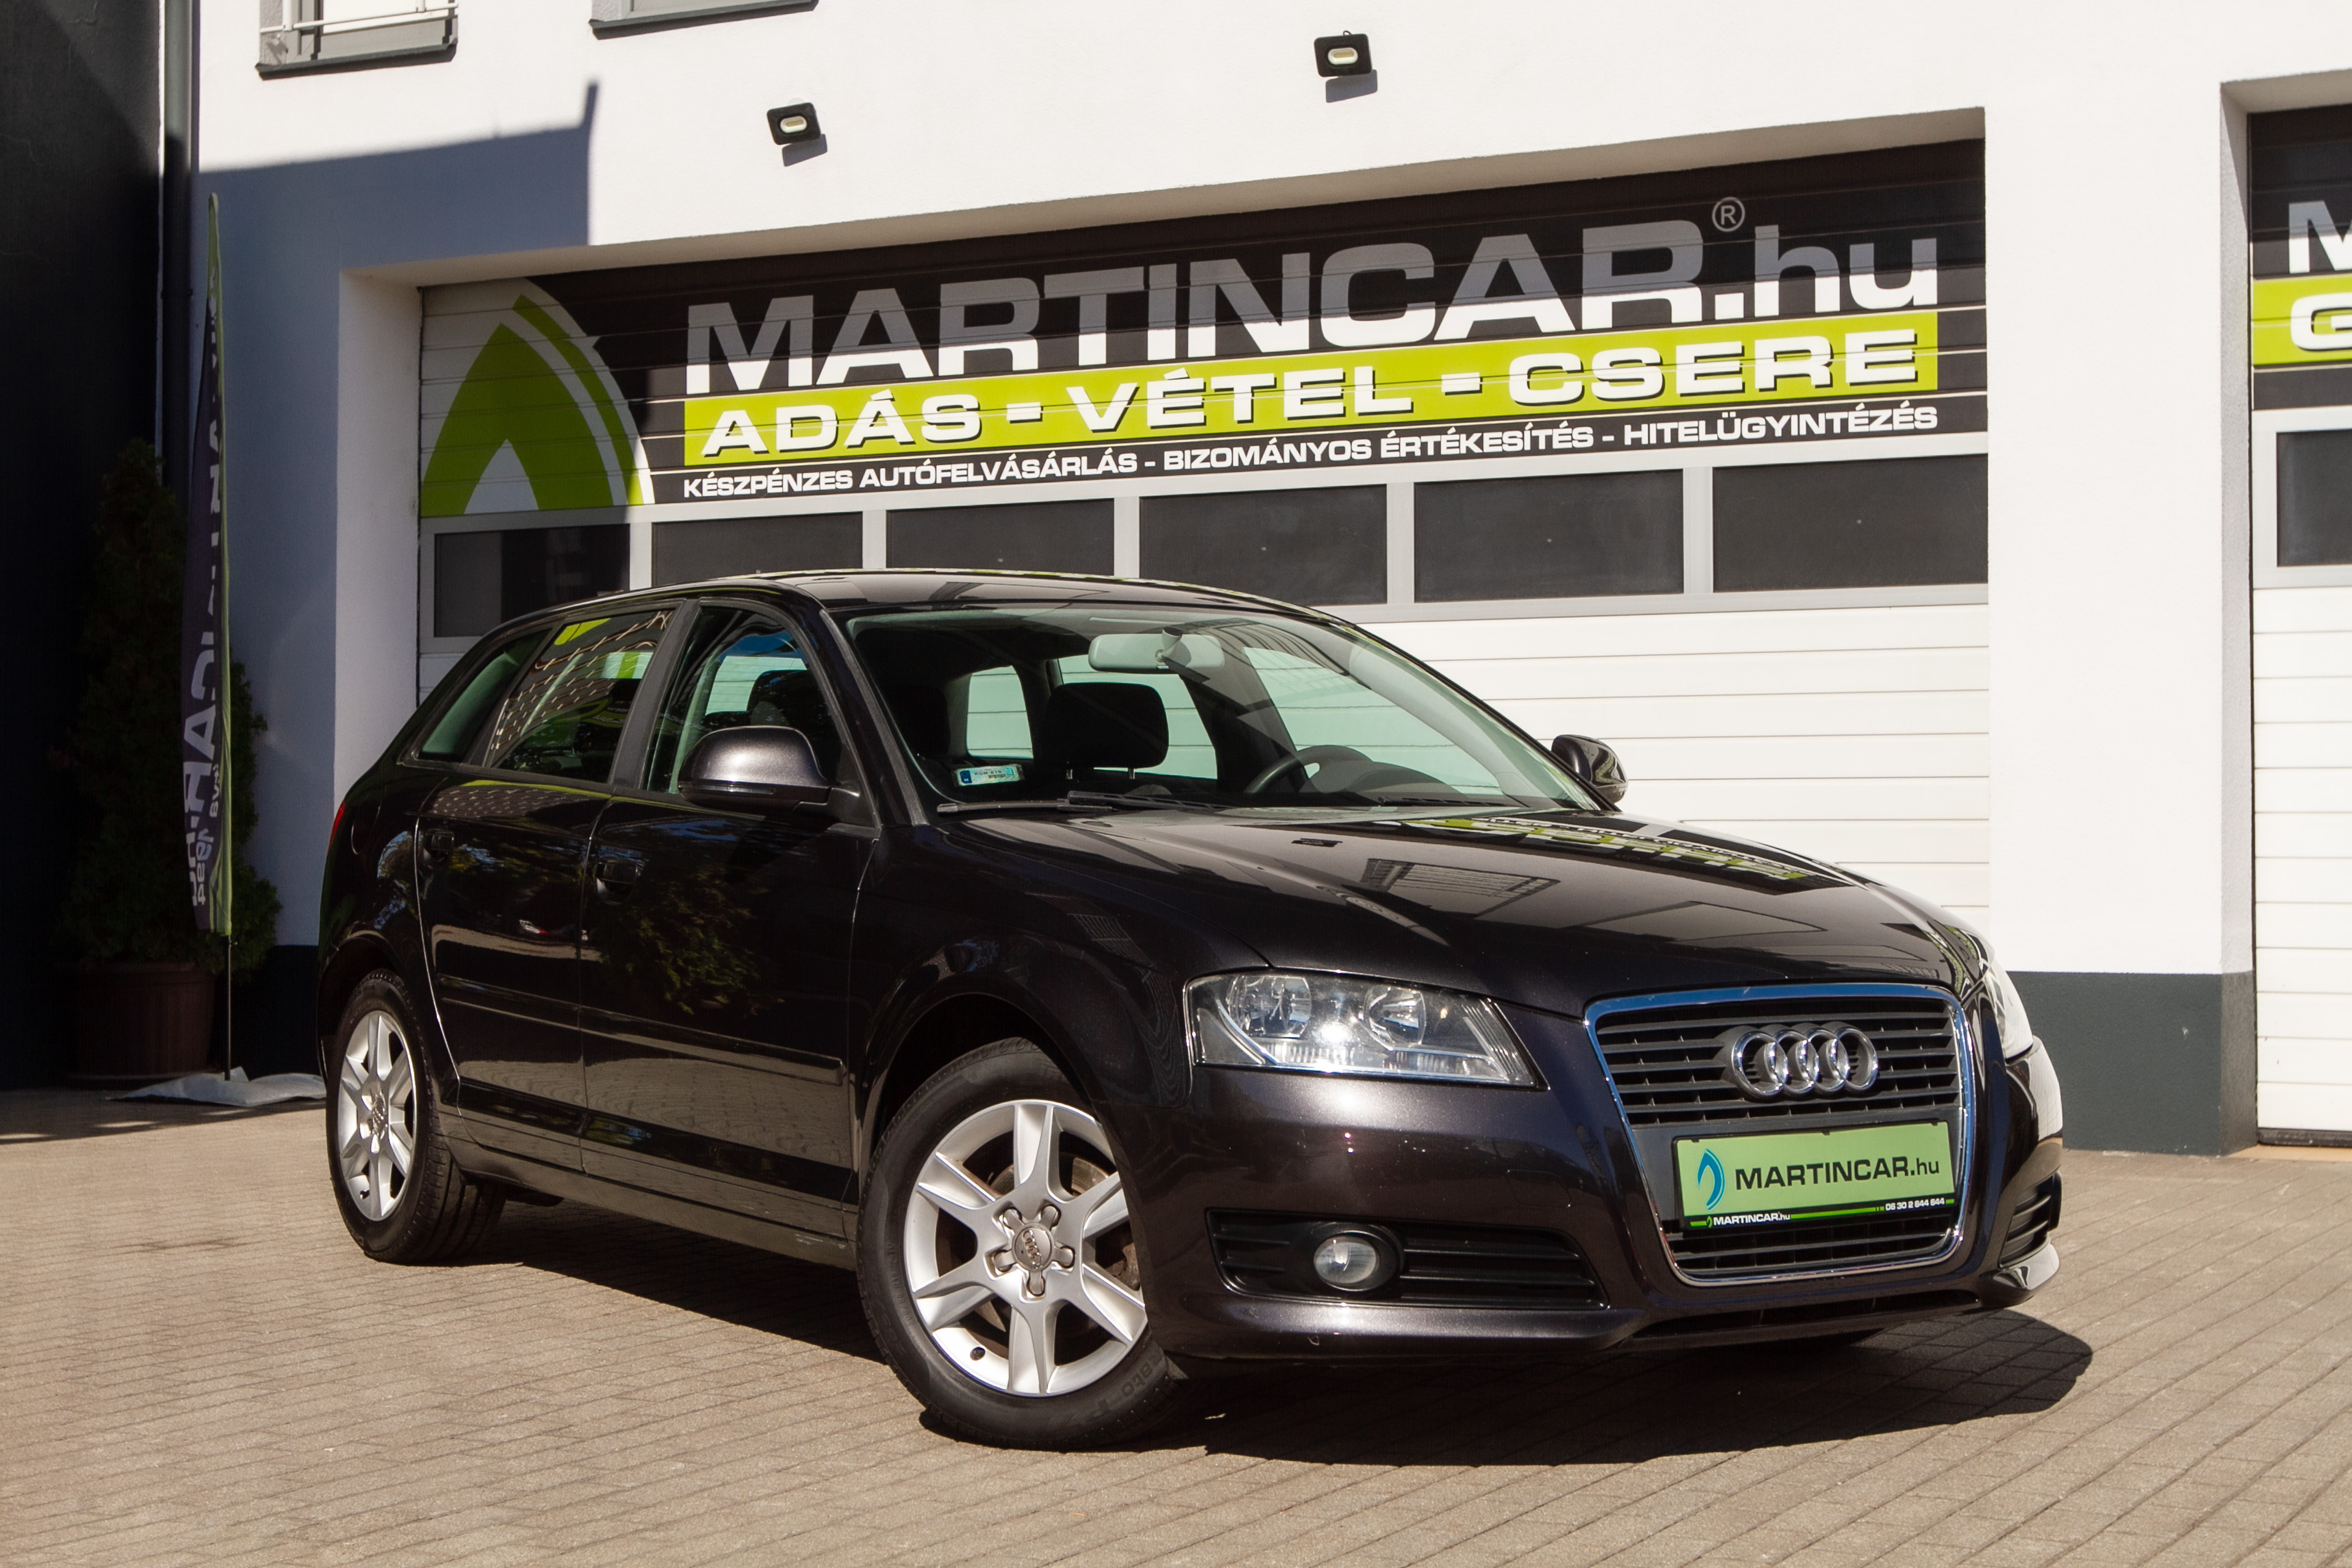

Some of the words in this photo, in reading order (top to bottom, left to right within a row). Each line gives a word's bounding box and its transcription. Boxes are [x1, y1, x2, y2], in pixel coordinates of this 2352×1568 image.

[686, 219, 1938, 394] MARTINCAR.hu
[700, 388, 982, 460] ADÁS
[1066, 365, 1413, 433] VÉTEL
[1508, 329, 1918, 406] CSERE
[683, 463, 853, 498] KÉSZPÉNZES
[859, 447, 1137, 490] AUTÓFELVÁSÁRLÁS
[1163, 437, 1372, 471] BIZOMÁNYOS
[1379, 420, 1594, 458] ÉRTÉKESÍTÉS
[1623, 401, 1938, 447] HITELÜGYINTÉZÉS
[1735, 1156, 1940, 1191] MARTINCAR.hu
[1885, 1202, 1896, 1211] 06
[1897, 1201, 1907, 1210] 30
[1915, 1199, 1929, 1208] 644
[1930, 1198, 1945, 1206] 644
[1713, 1212, 1790, 1226] MARTINCAR.hu
